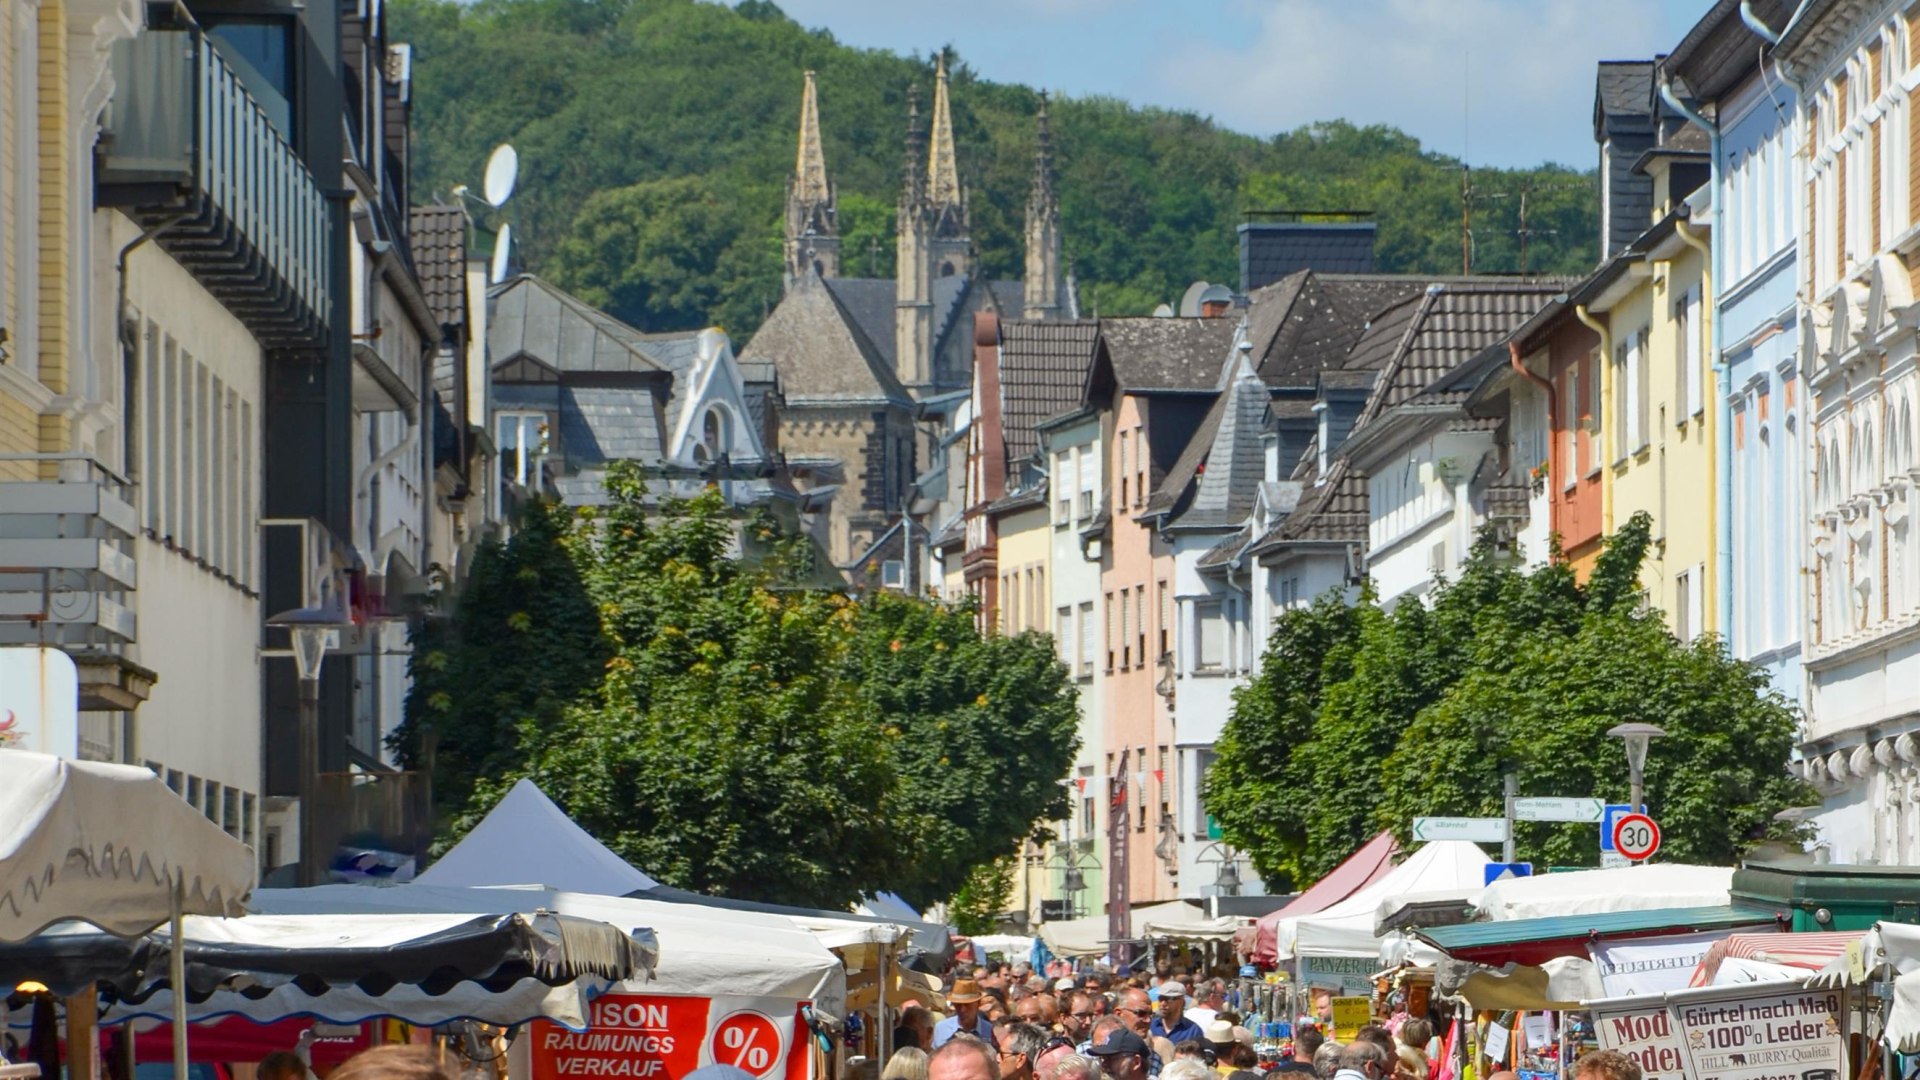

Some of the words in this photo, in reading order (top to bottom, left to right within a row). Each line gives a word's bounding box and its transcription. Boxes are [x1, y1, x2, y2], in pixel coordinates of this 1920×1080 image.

[1623, 826, 1650, 848] 30
[1310, 957, 1360, 973] PANZER
[591, 1003, 668, 1028] ISON
[1685, 1004, 1746, 1027] Gürtel
[1748, 998, 1794, 1021] nach
[1797, 994, 1839, 1016] Maß
[1612, 1010, 1673, 1046] Mod
[1706, 1024, 1763, 1050] 100%
[1766, 1020, 1824, 1044] Leder
[544, 1031, 675, 1054] RÄUMUNGS
[555, 1057, 664, 1078] VERKAUF
[1701, 1056, 1729, 1070] HILL
[1748, 1046, 1832, 1066] BURRY-Qualität
